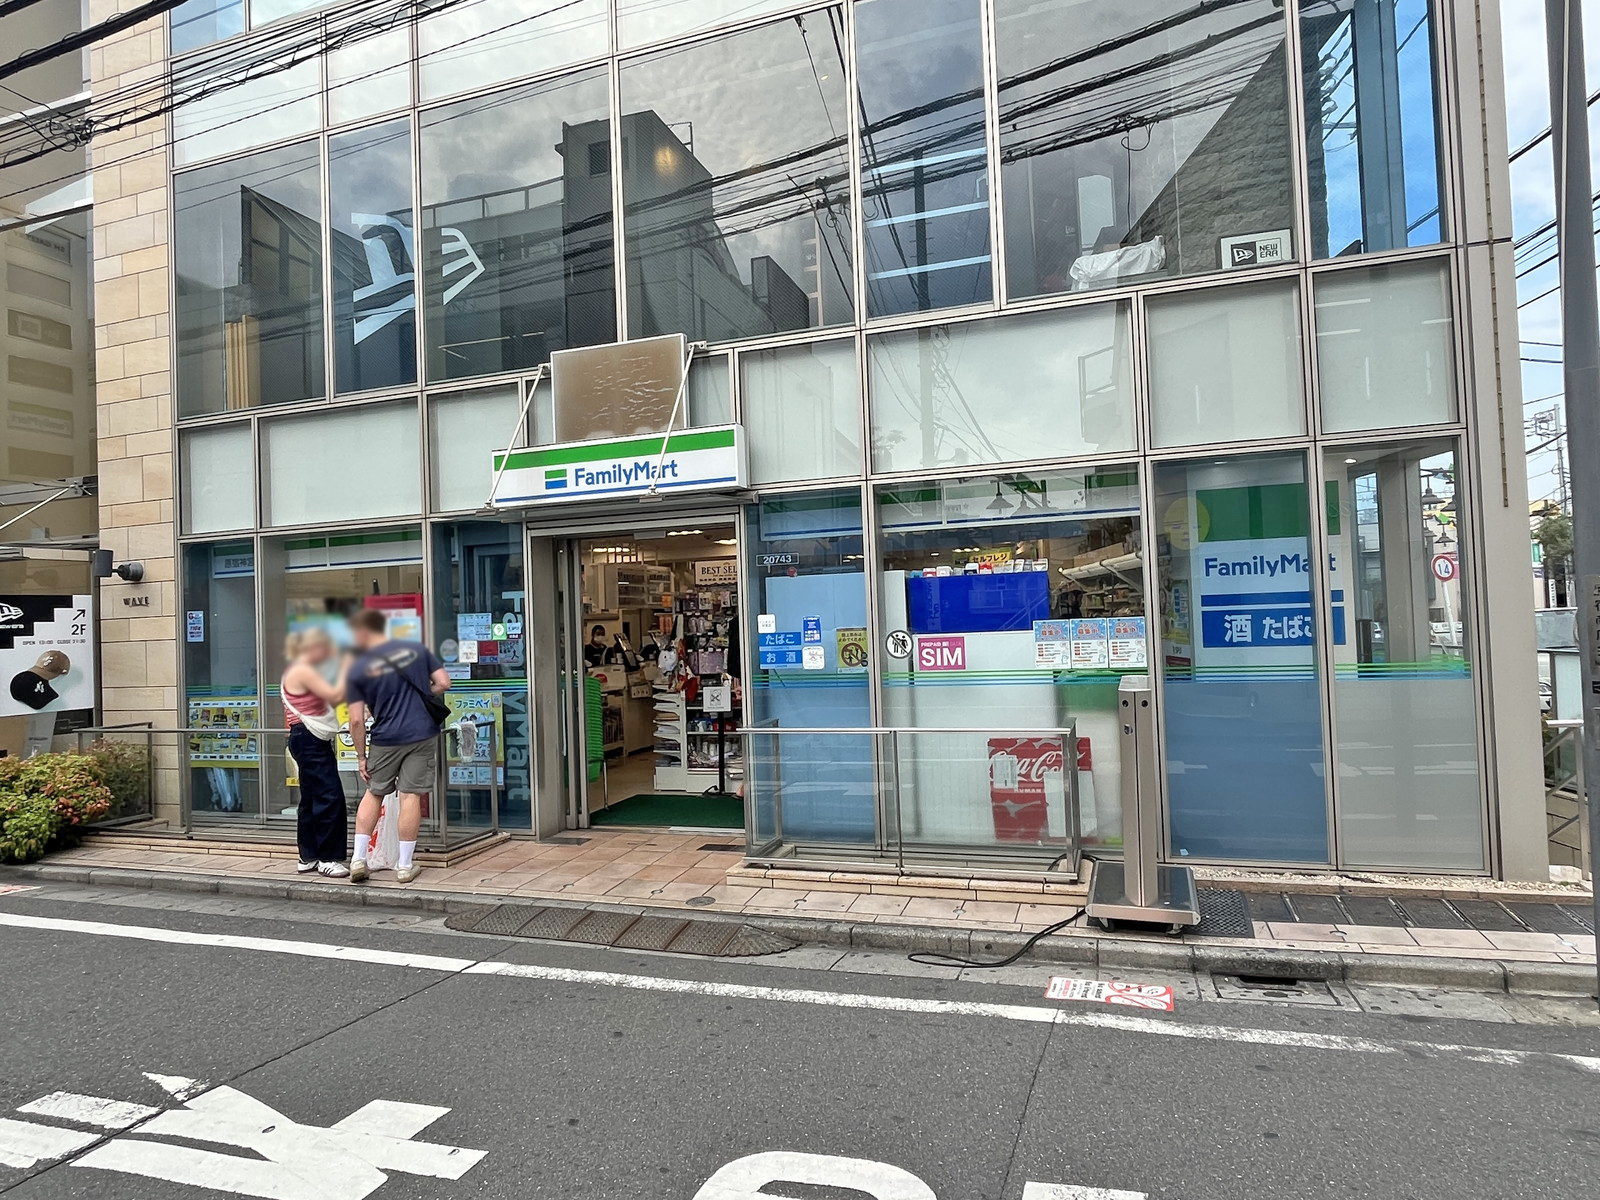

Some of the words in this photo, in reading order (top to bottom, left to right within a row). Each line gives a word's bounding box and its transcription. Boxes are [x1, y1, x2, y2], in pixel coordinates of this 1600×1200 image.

[1259, 243, 1278, 251] NEW
[1259, 250, 1279, 258] ERA
[574, 459, 679, 487] FamilyMart
[763, 555, 792, 564] 20743
[1204, 552, 1337, 577] FamilyMat
[701, 566, 721, 575] BEST
[123, 596, 150, 606] WAVE
[71, 624, 87, 635] 2F
[1224, 614, 1253, 643] 酒
[765, 634, 795, 645] たばこ
[921, 647, 963, 667] SIM
[455, 699, 491, 709] ファミペイ
